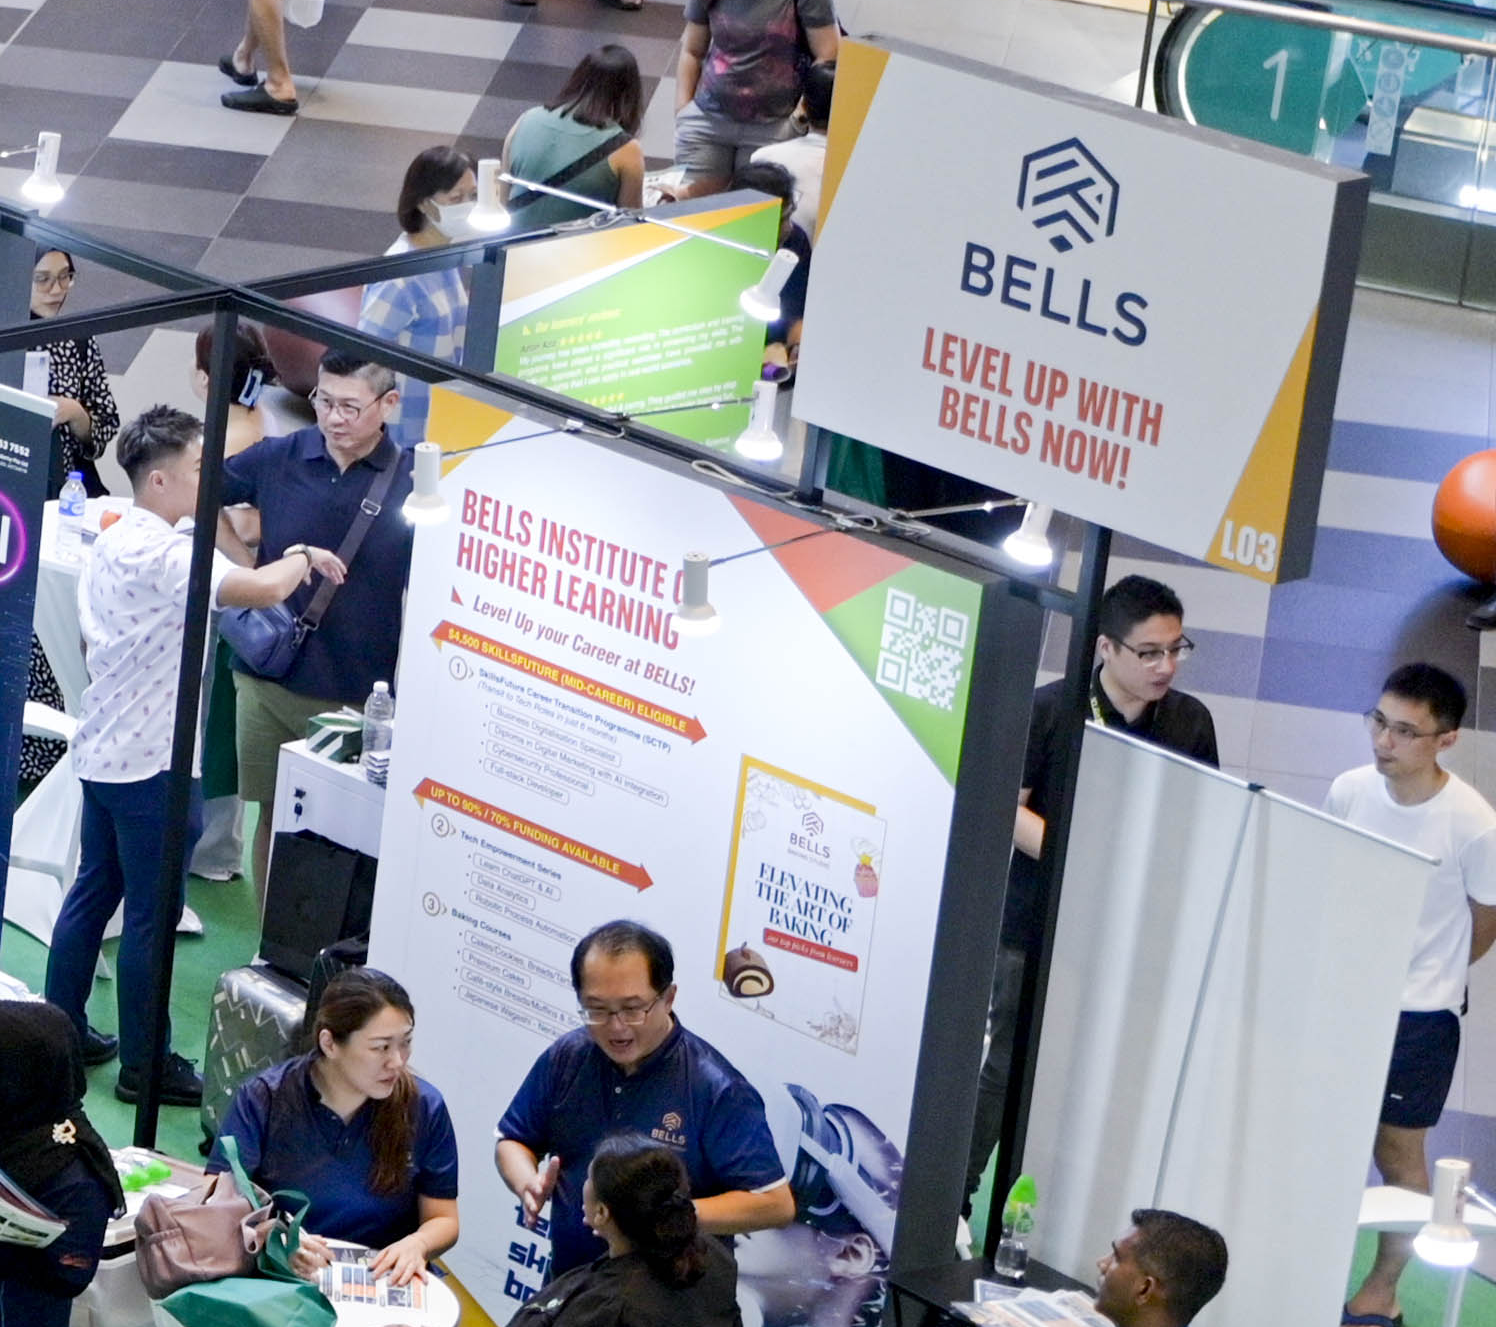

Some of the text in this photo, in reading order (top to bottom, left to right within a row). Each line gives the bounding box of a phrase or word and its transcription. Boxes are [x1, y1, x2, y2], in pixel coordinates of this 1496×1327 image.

[960, 241, 1149, 347] BELLS
[921, 326, 1164, 447] LEVEL UP WITH
[938, 385, 1132, 490] BELLS NOW!
[455, 531, 681, 652] HIGHER LEARNING
[461, 487, 670, 597] BELLS INSTITUTE
[1219, 517, 1279, 572] L03
